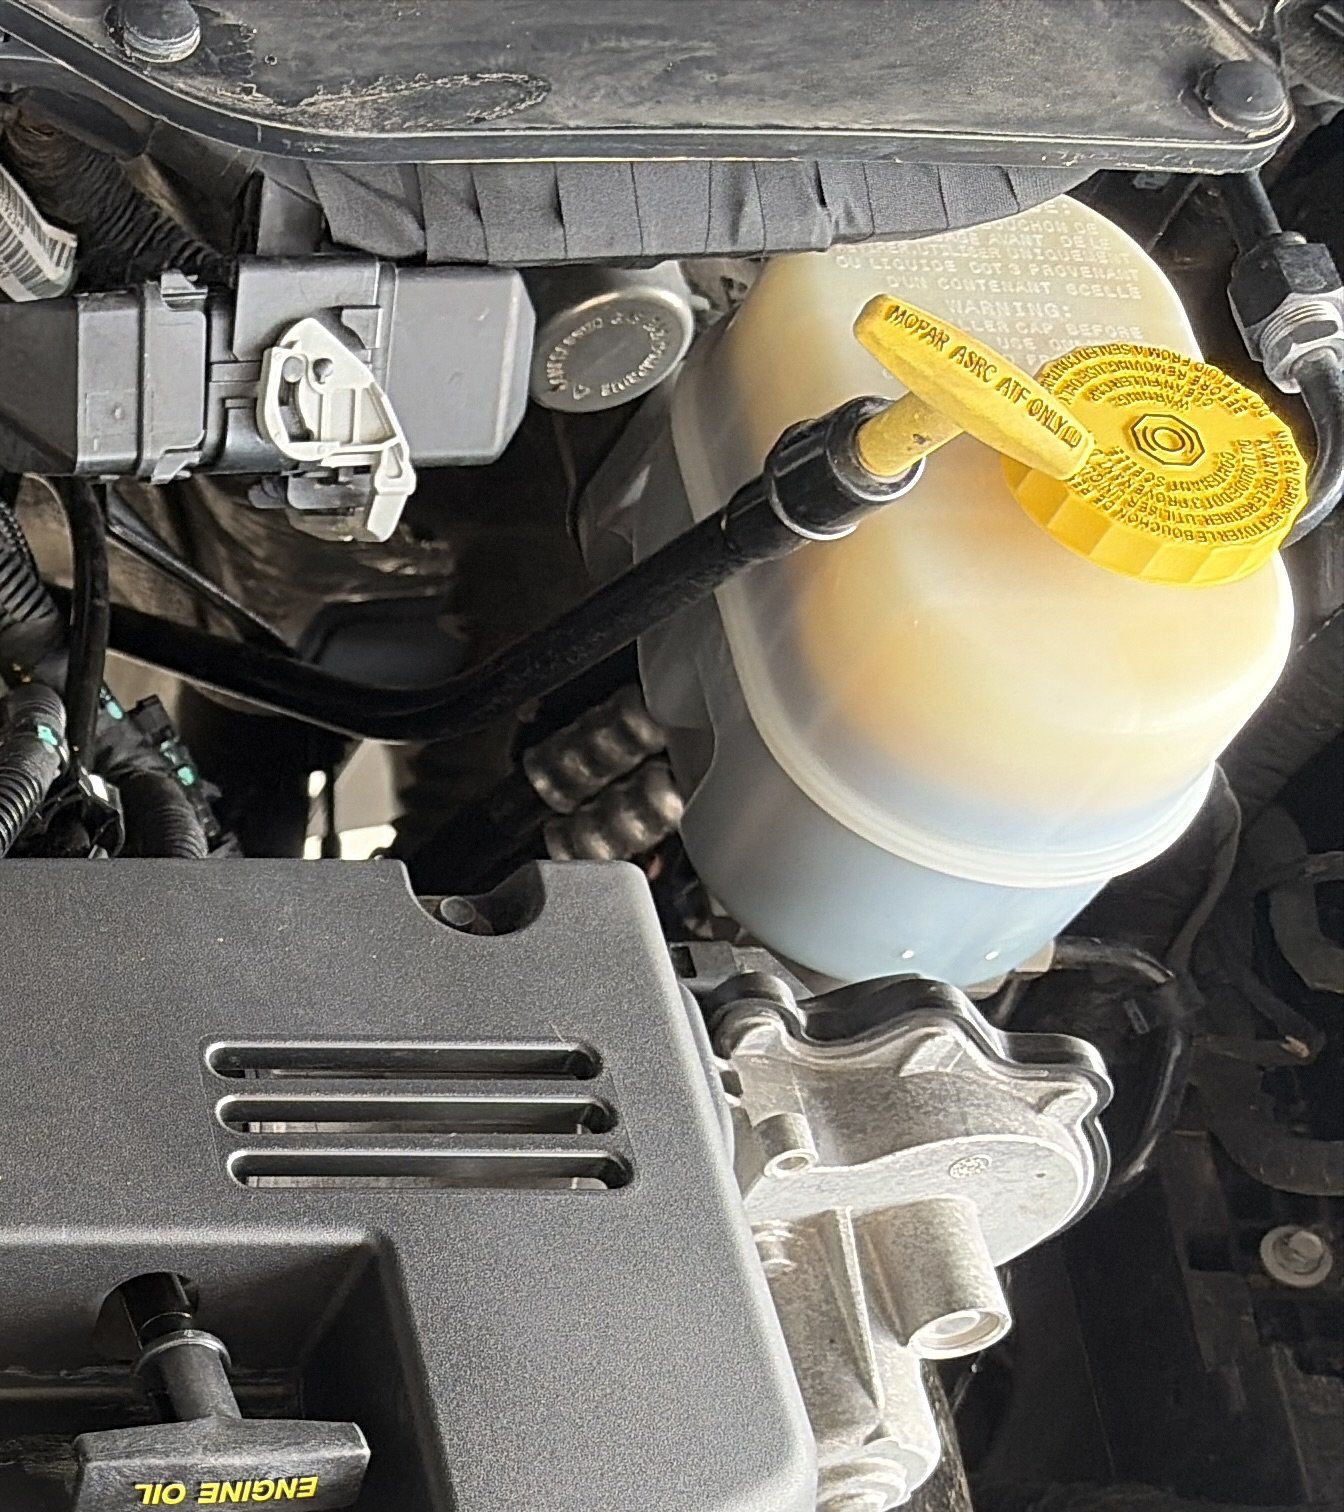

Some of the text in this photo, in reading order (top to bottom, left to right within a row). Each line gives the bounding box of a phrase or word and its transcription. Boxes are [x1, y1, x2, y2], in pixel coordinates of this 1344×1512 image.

[944, 299, 1072, 318] WARNING:
[885, 304, 951, 353] MOPAR
[134, 1475, 320, 1506] ENGINE OIL
